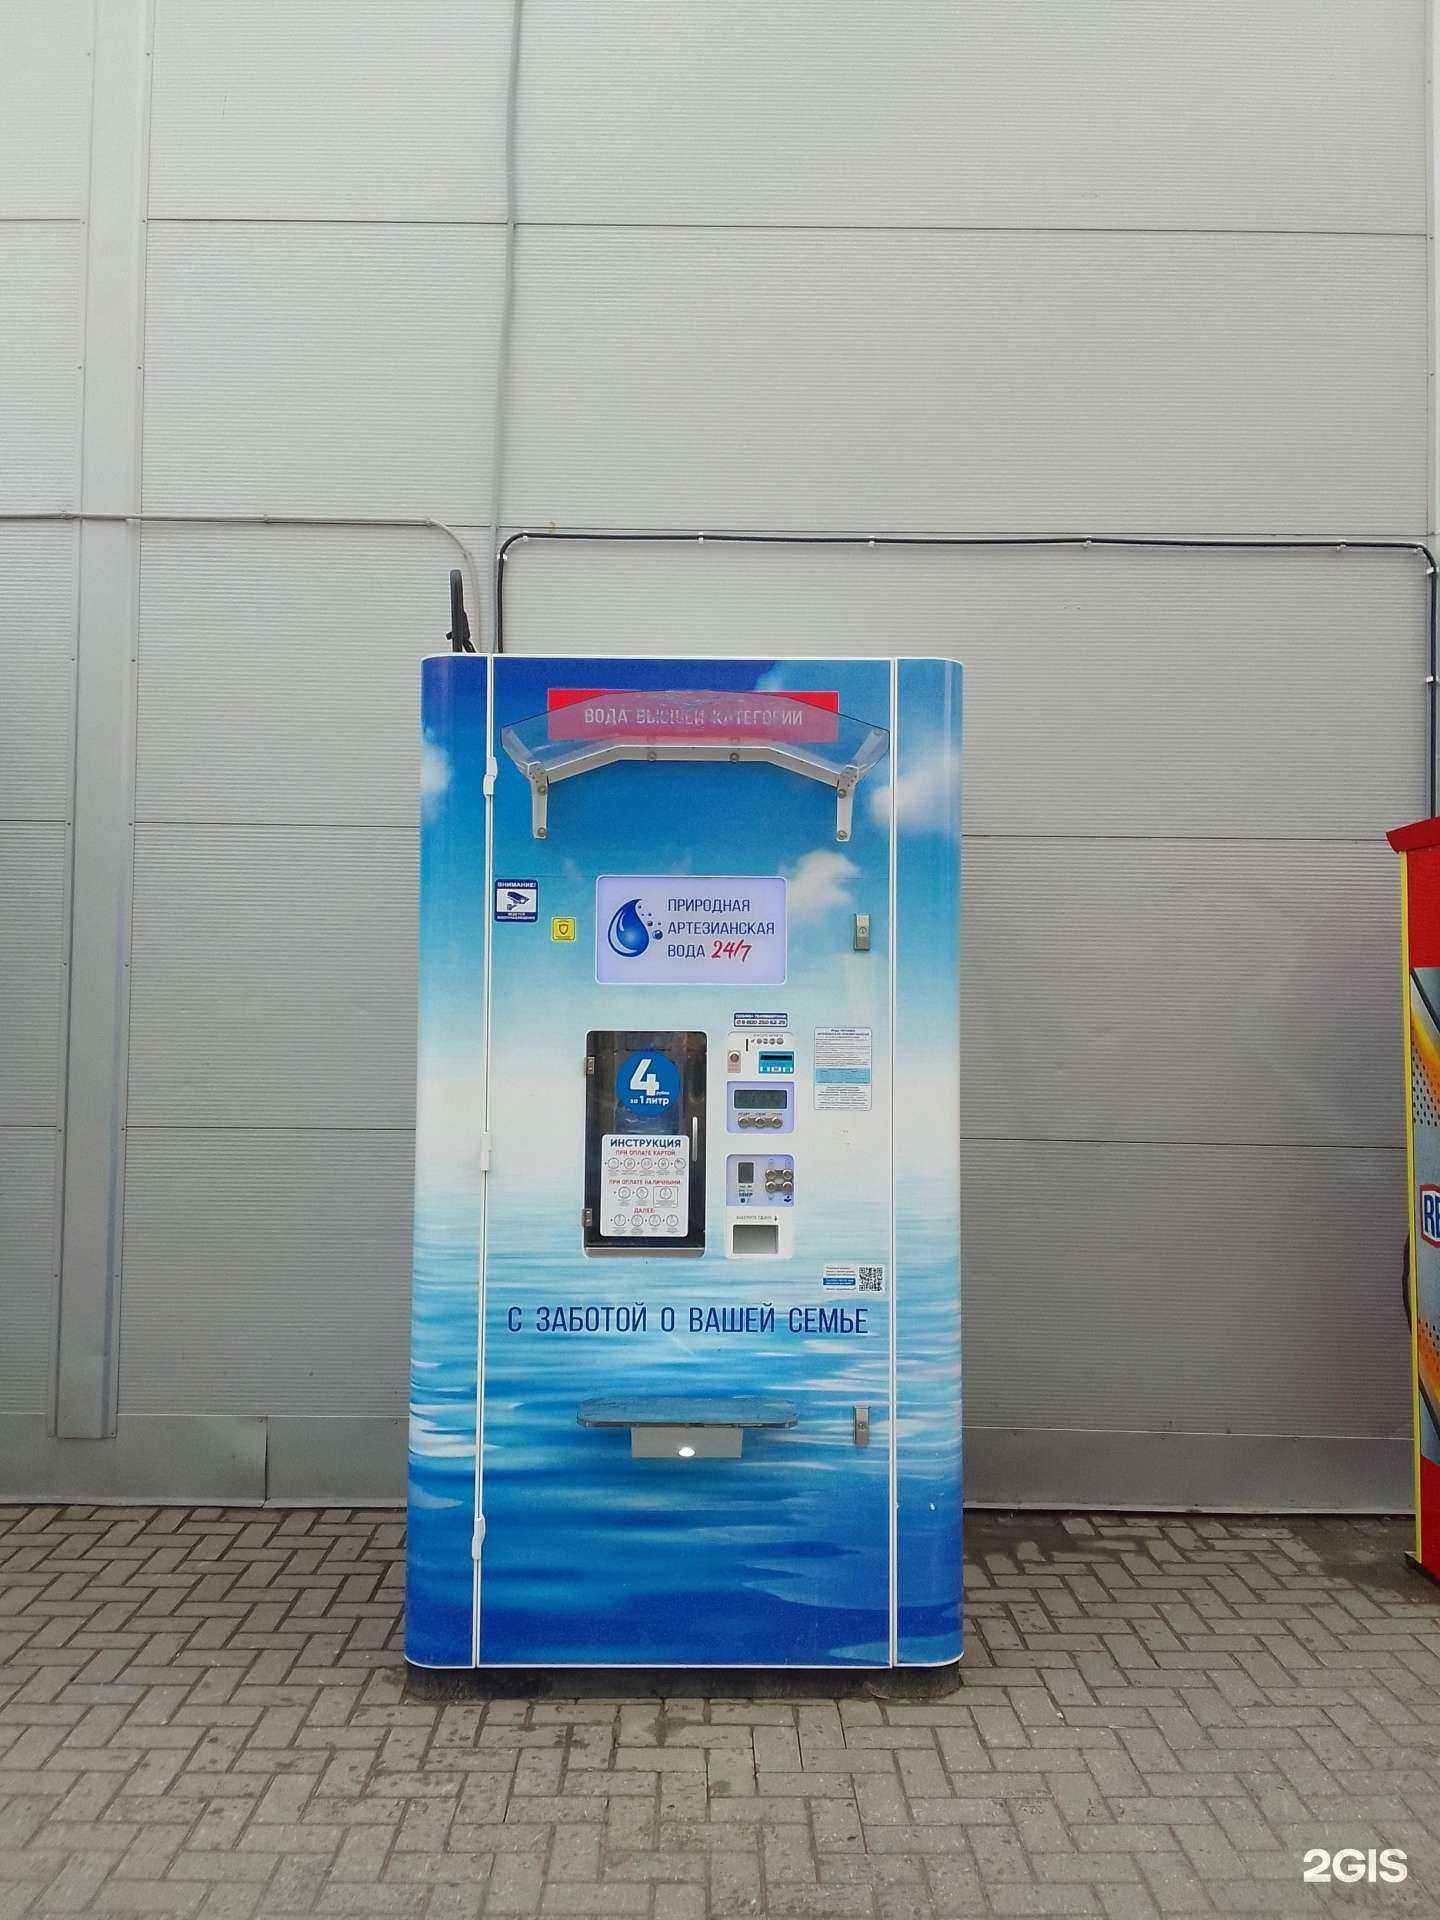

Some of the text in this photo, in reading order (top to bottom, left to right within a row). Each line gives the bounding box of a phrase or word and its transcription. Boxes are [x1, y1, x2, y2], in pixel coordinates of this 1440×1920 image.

[584, 709, 628, 726] ВОДА
[667, 898, 751, 914] ПРИРОДНАЯ
[667, 921, 775, 935] АРТЕЗИАНСКАЯ
[667, 939, 753, 963] ВОДА 24/7
[630, 1058, 660, 1096] 4
[639, 1095, 645, 1104] 1
[646, 1097, 670, 1106] литр
[610, 1138, 682, 1149] ИНСТРУКЦИЯ
[508, 1302, 869, 1334] С ЗАБОТОЙ О ВАШЕЙ СЕМЬЕ
